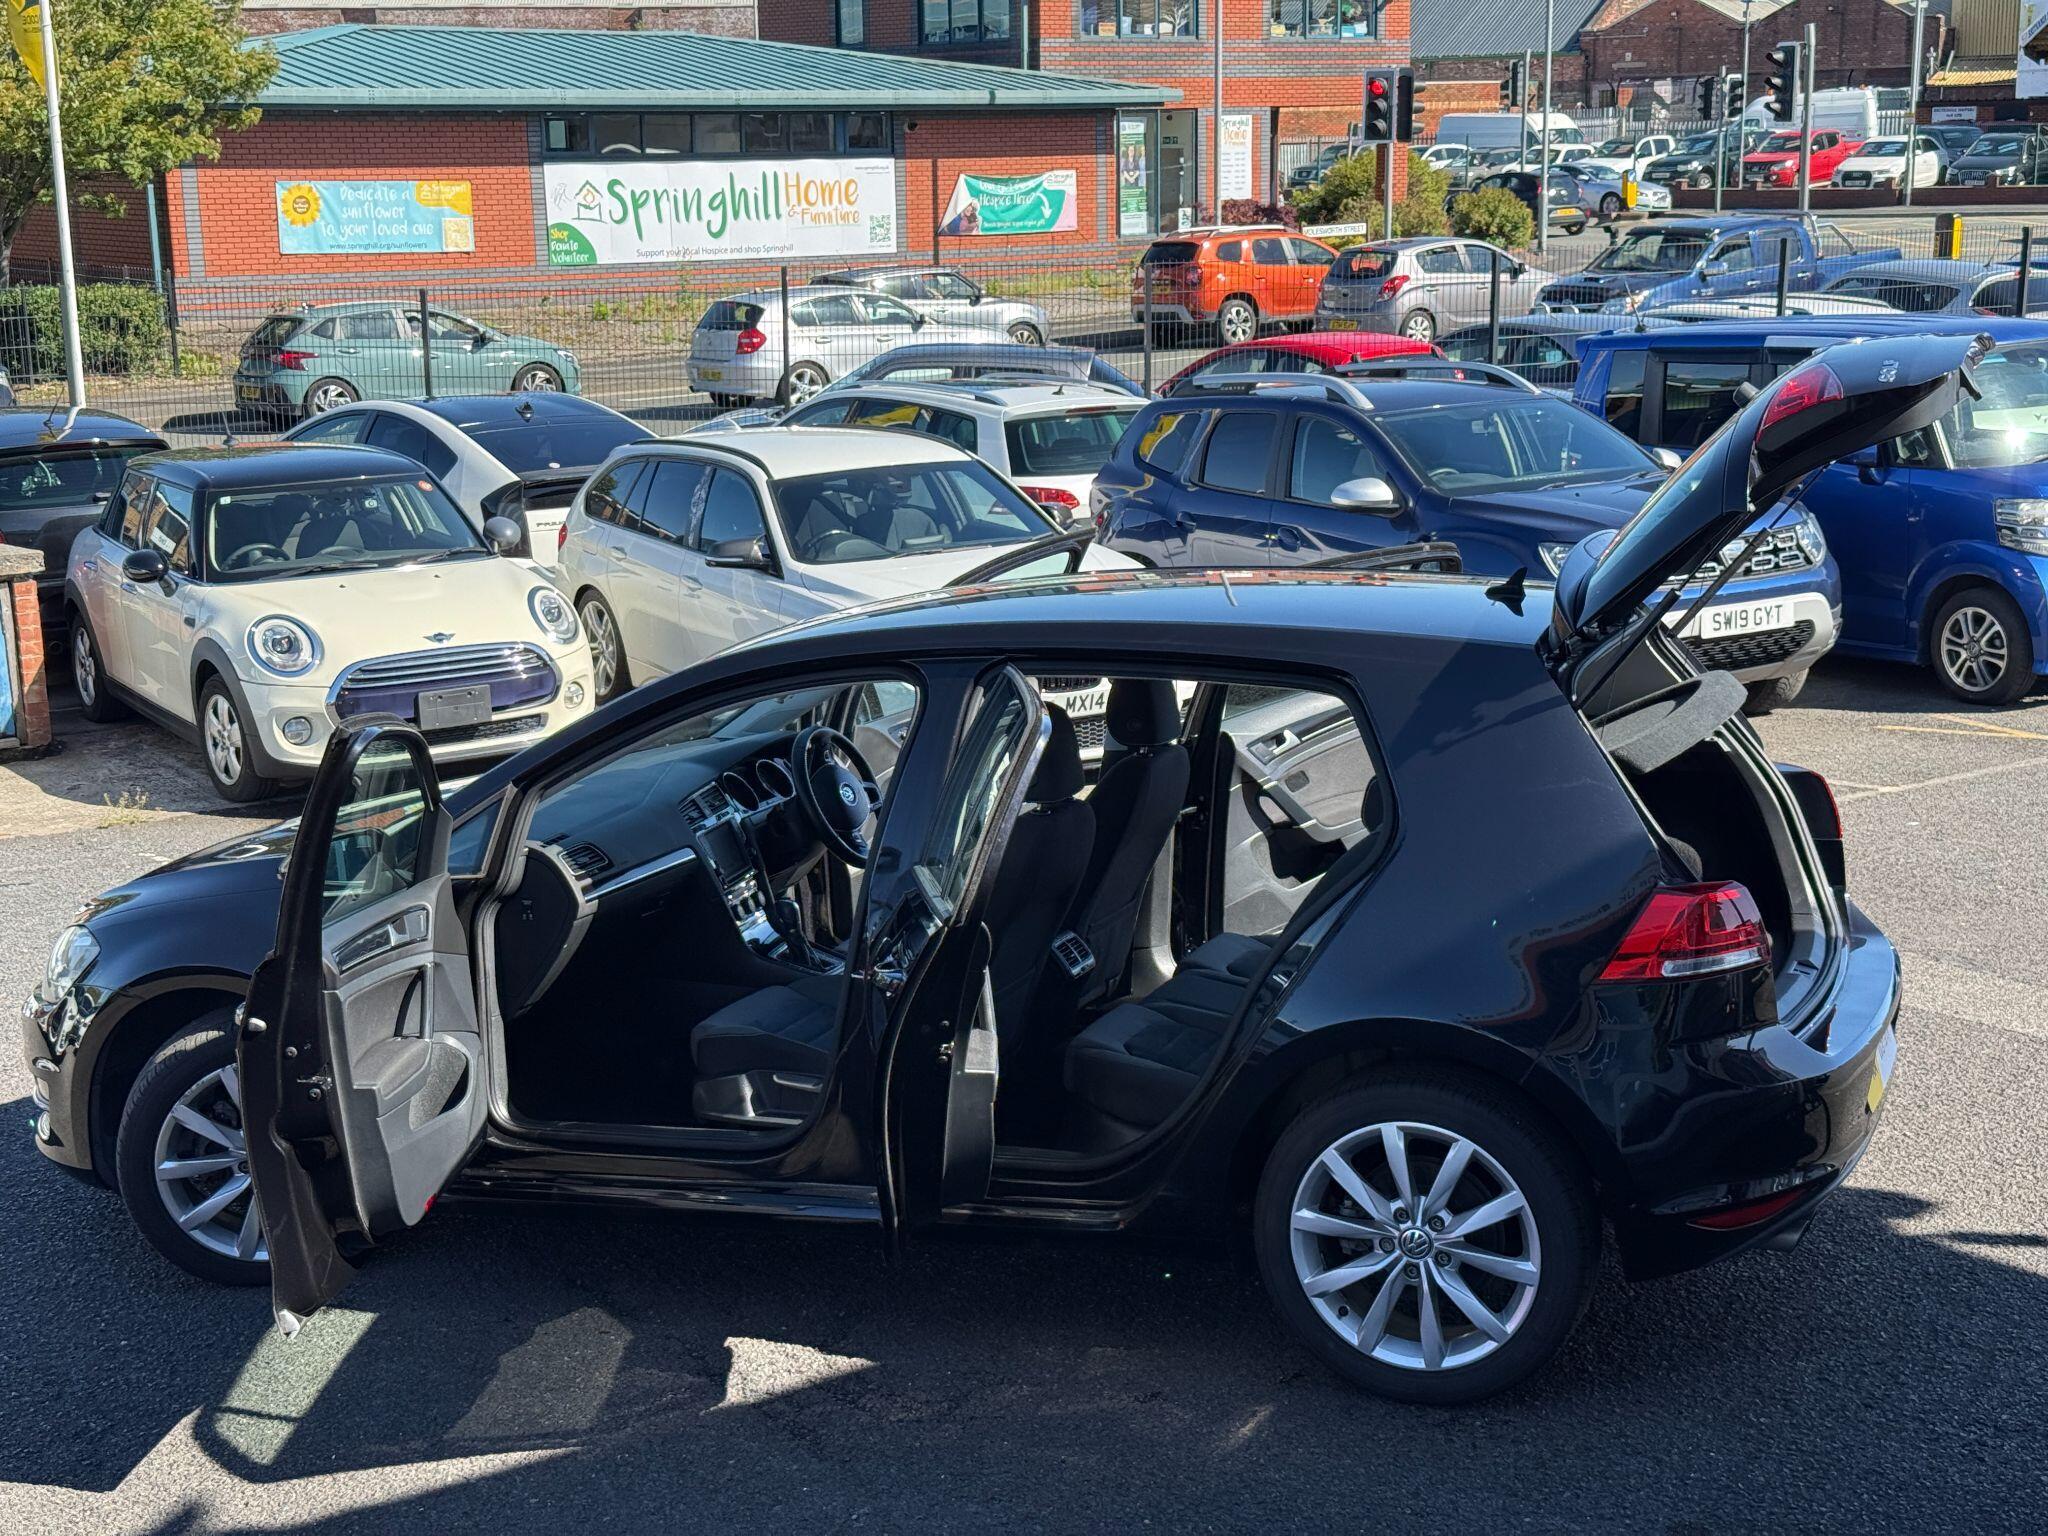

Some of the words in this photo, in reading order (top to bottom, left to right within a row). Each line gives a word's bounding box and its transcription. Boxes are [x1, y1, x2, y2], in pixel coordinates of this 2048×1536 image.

[340, 185, 397, 202] Dedicate
[402, 189, 410, 200] a
[342, 202, 405, 218] sunflower
[607, 170, 781, 241] Springhill
[784, 171, 859, 207] Home
[788, 204, 799, 217] &
[801, 206, 860, 225] Furniture
[340, 224, 368, 241] your
[373, 219, 408, 238] loved
[412, 223, 434, 236] one
[551, 228, 568, 242] Shop
[1344, 224, 1364, 233] STREET
[551, 240, 578, 251] Donate
[636, 249, 665, 258] Support
[666, 249, 682, 258] your
[683, 247, 700, 256] local
[702, 246, 729, 256] Hospice
[730, 245, 743, 254] and
[744, 244, 761, 255] shop
[763, 243, 794, 255] Springhill
[551, 252, 589, 263] Volunteer
[1712, 609, 1749, 632] SW19
[1753, 604, 1783, 626] GYT
[1065, 693, 1105, 713] MX14
